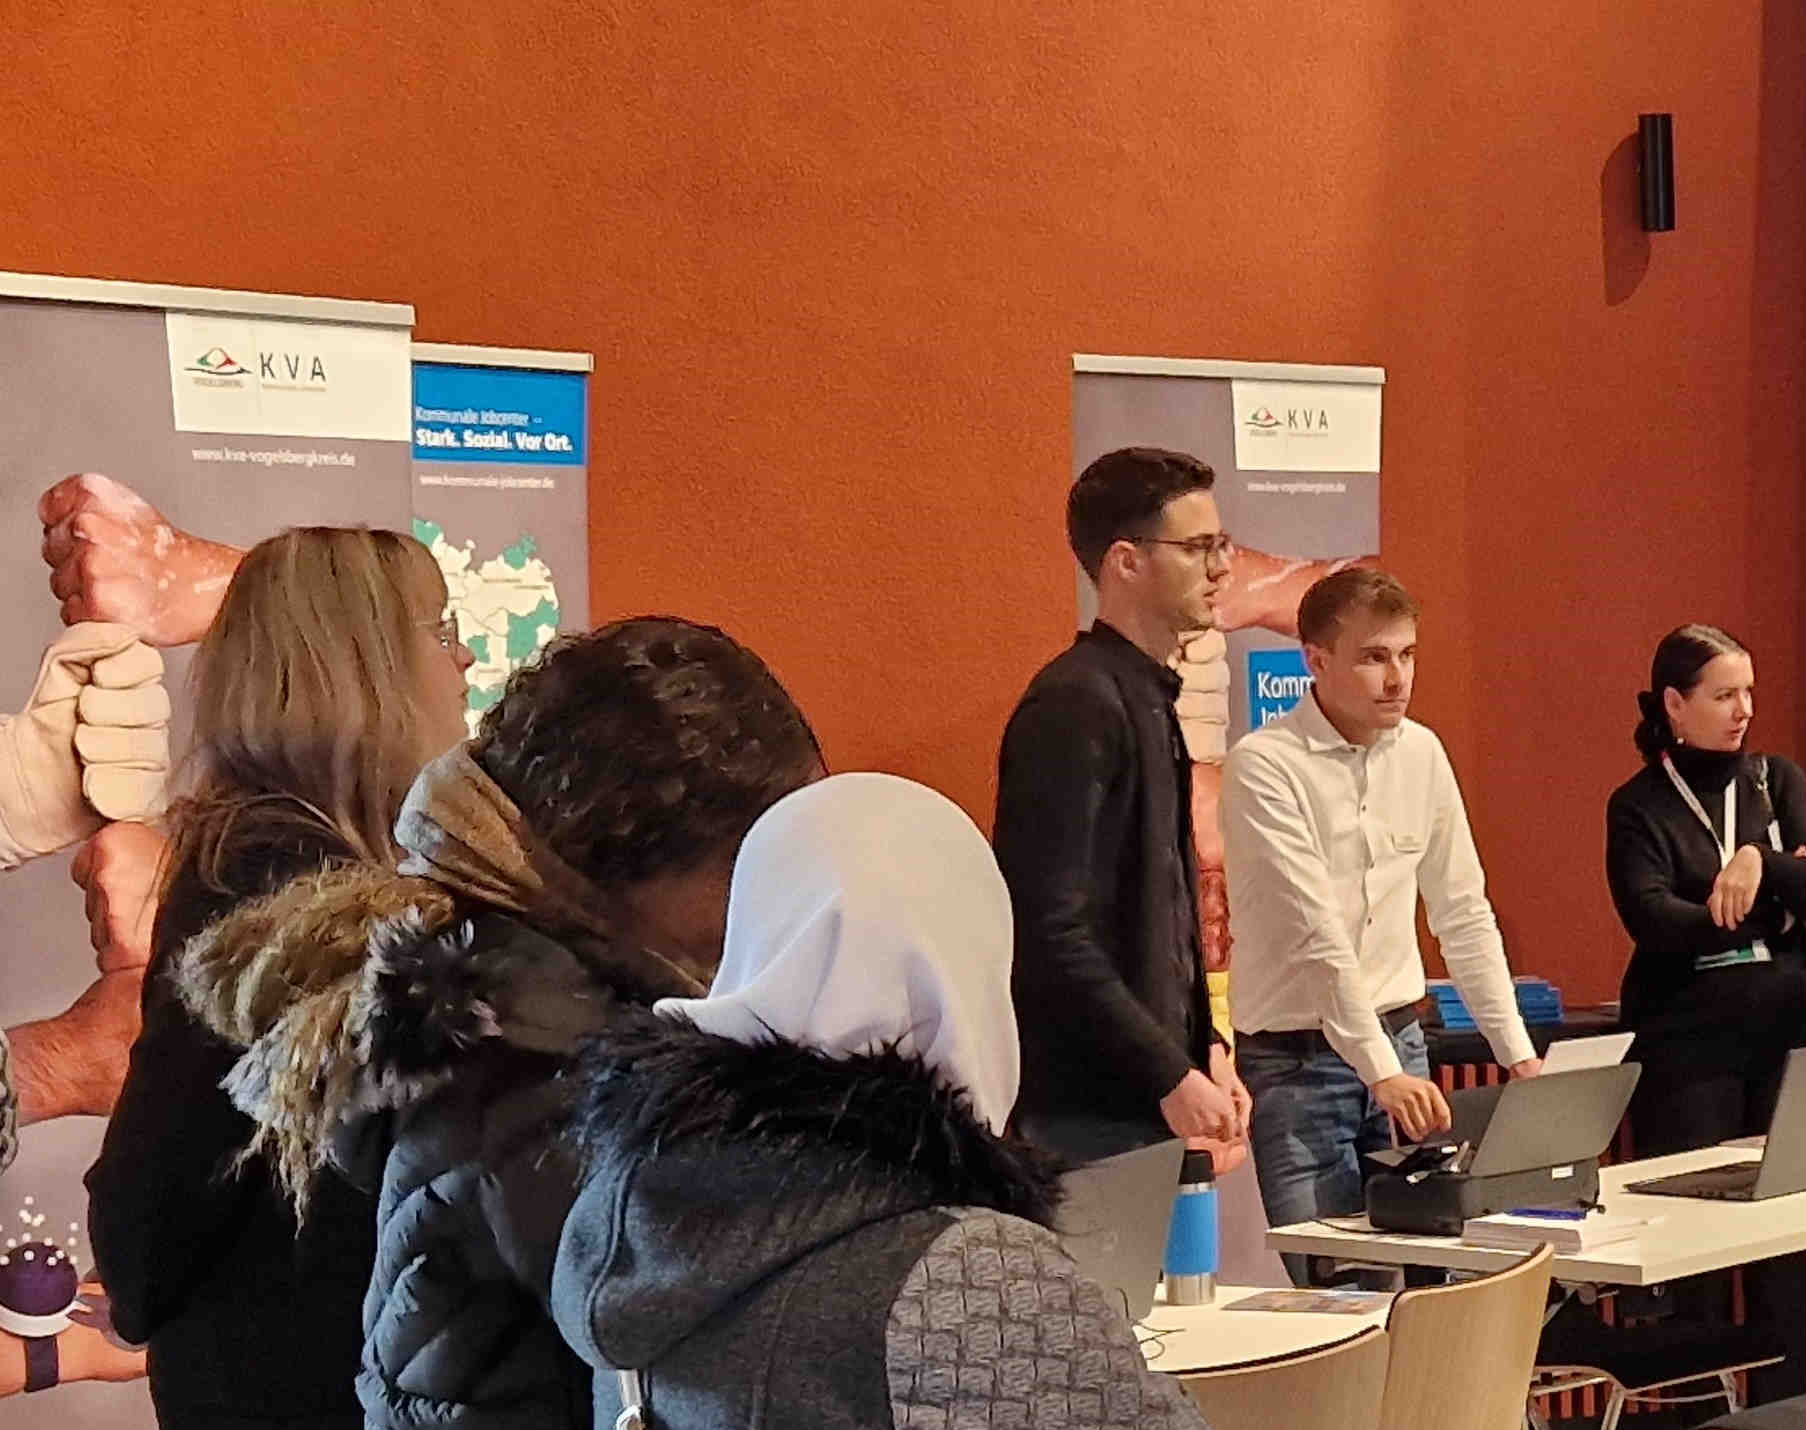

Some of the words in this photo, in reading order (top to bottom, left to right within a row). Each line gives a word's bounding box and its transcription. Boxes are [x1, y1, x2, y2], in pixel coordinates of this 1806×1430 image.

[416, 427, 461, 447] Stark.
[463, 429, 512, 449] Sozial.
[515, 431, 542, 451] Vor
[544, 432, 573, 451] Ort.
